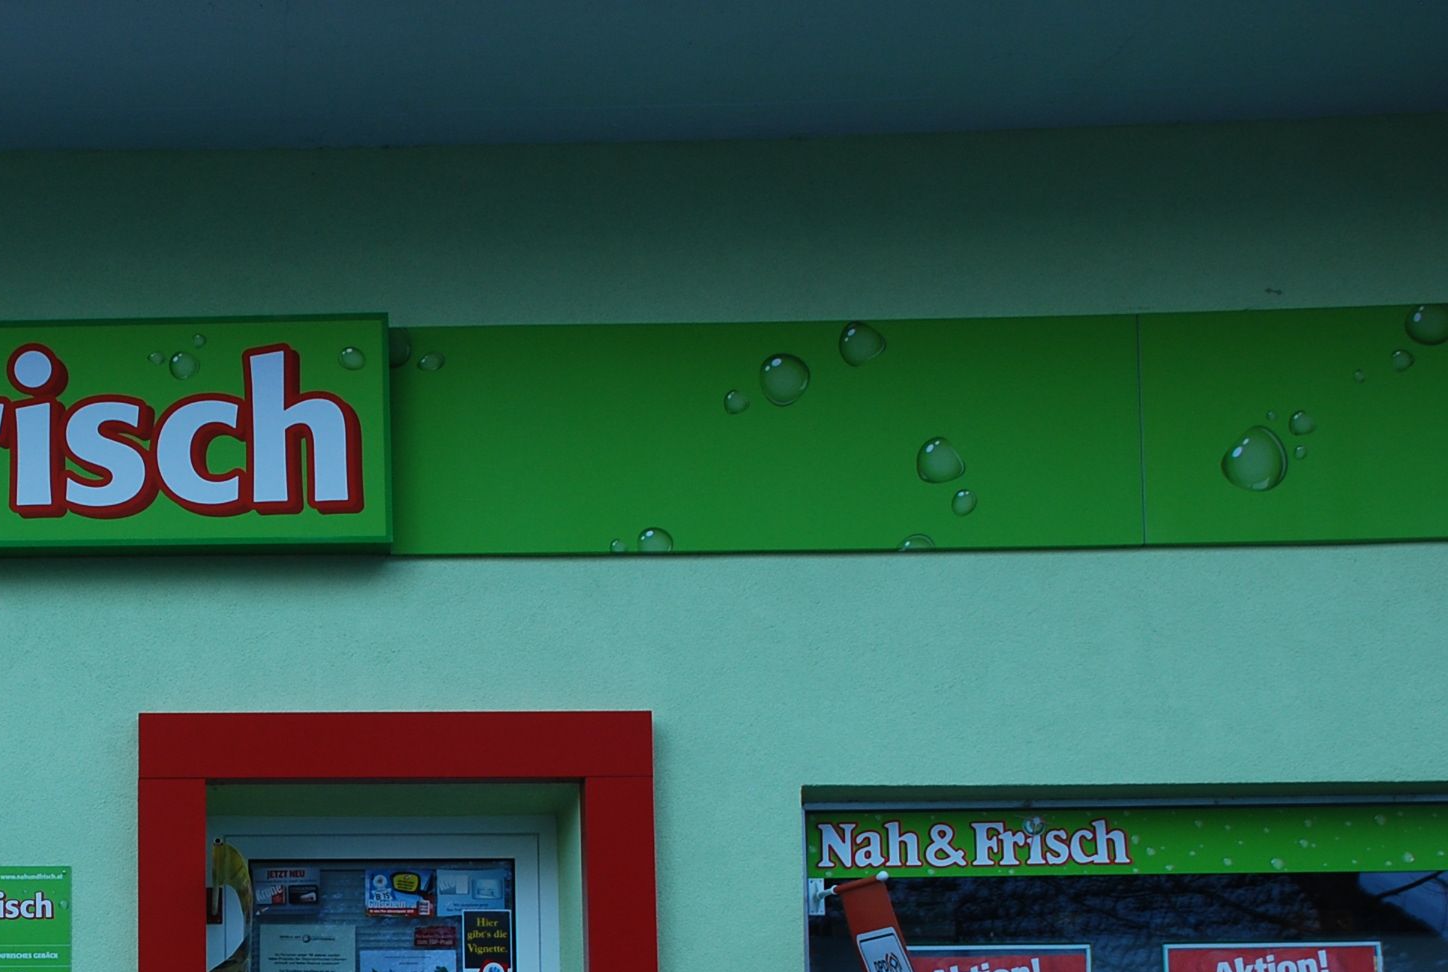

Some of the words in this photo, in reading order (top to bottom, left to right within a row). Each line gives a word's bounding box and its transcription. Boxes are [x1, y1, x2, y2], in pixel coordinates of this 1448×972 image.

[816, 819, 922, 867] Nah
[924, 822, 968, 867] &
[970, 818, 1131, 865] Frisch
[476, 917, 498, 927] Hier
[467, 930, 492, 941] gibt's
[493, 929, 508, 938] die
[467, 944, 508, 956] Vignette.
